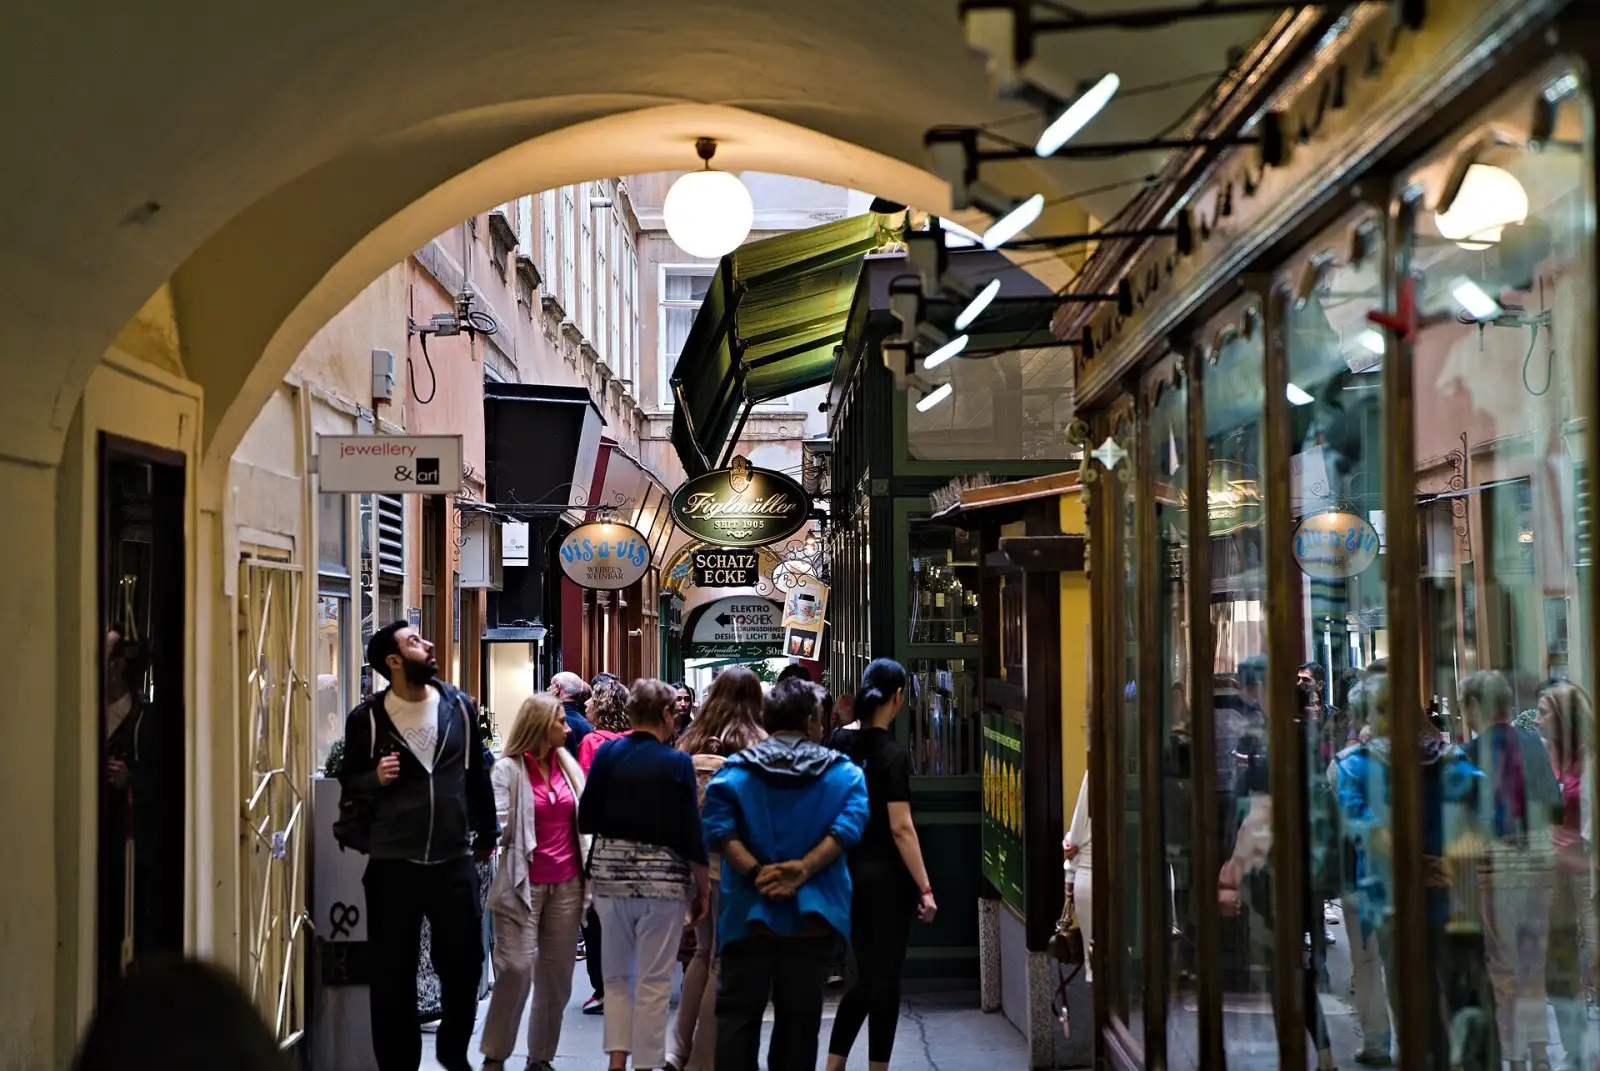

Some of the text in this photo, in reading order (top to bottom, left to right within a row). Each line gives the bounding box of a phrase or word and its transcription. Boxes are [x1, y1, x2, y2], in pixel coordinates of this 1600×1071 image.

[340, 442, 417, 459] jewellery
[394, 465, 438, 482] & art
[682, 492, 796, 520] Figlmüller
[714, 520, 765, 529] SEIT 1905
[560, 538, 647, 567] vis-a-vis
[704, 570, 747, 584] ECKE
[730, 605, 770, 613] ELEKTRO
